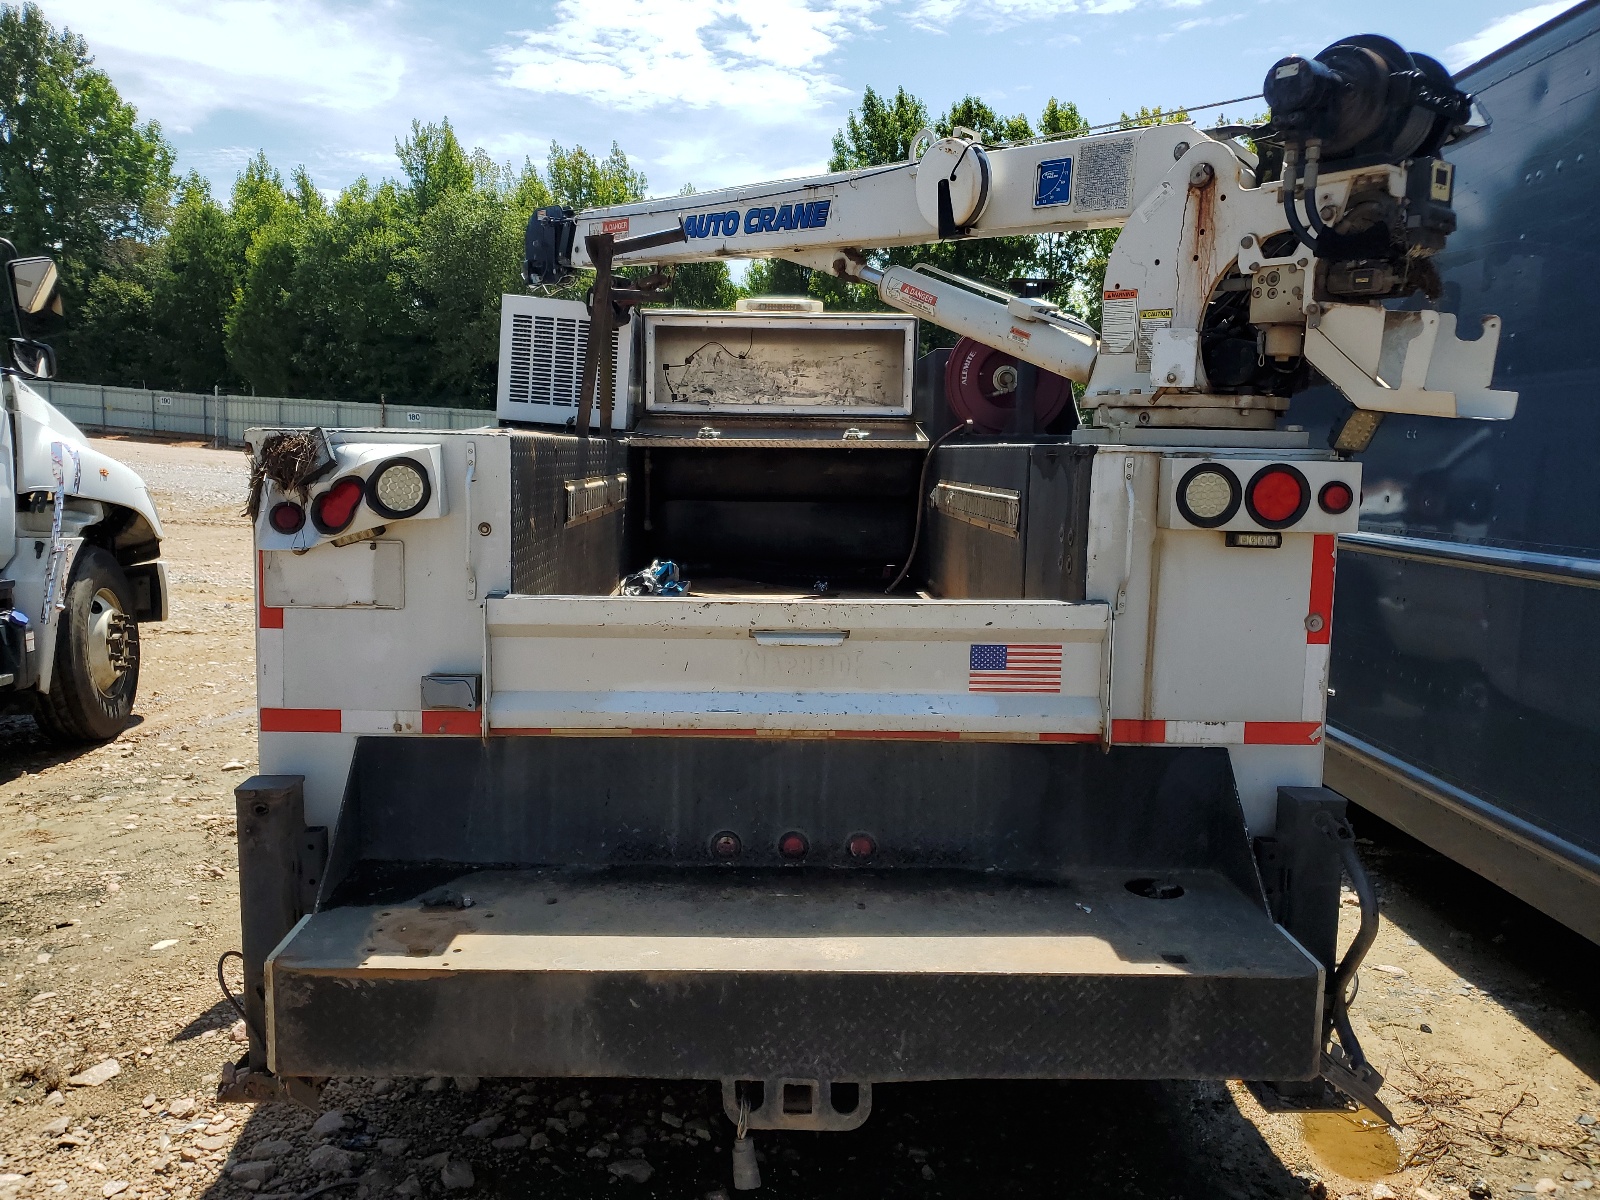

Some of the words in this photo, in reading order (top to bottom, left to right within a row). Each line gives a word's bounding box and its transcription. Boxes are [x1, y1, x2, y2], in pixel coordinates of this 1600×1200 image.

[684, 211, 740, 239] AUTO
[743, 199, 832, 235] CRANE
[909, 286, 934, 304] DANGER
[408, 413, 420, 421] 180
